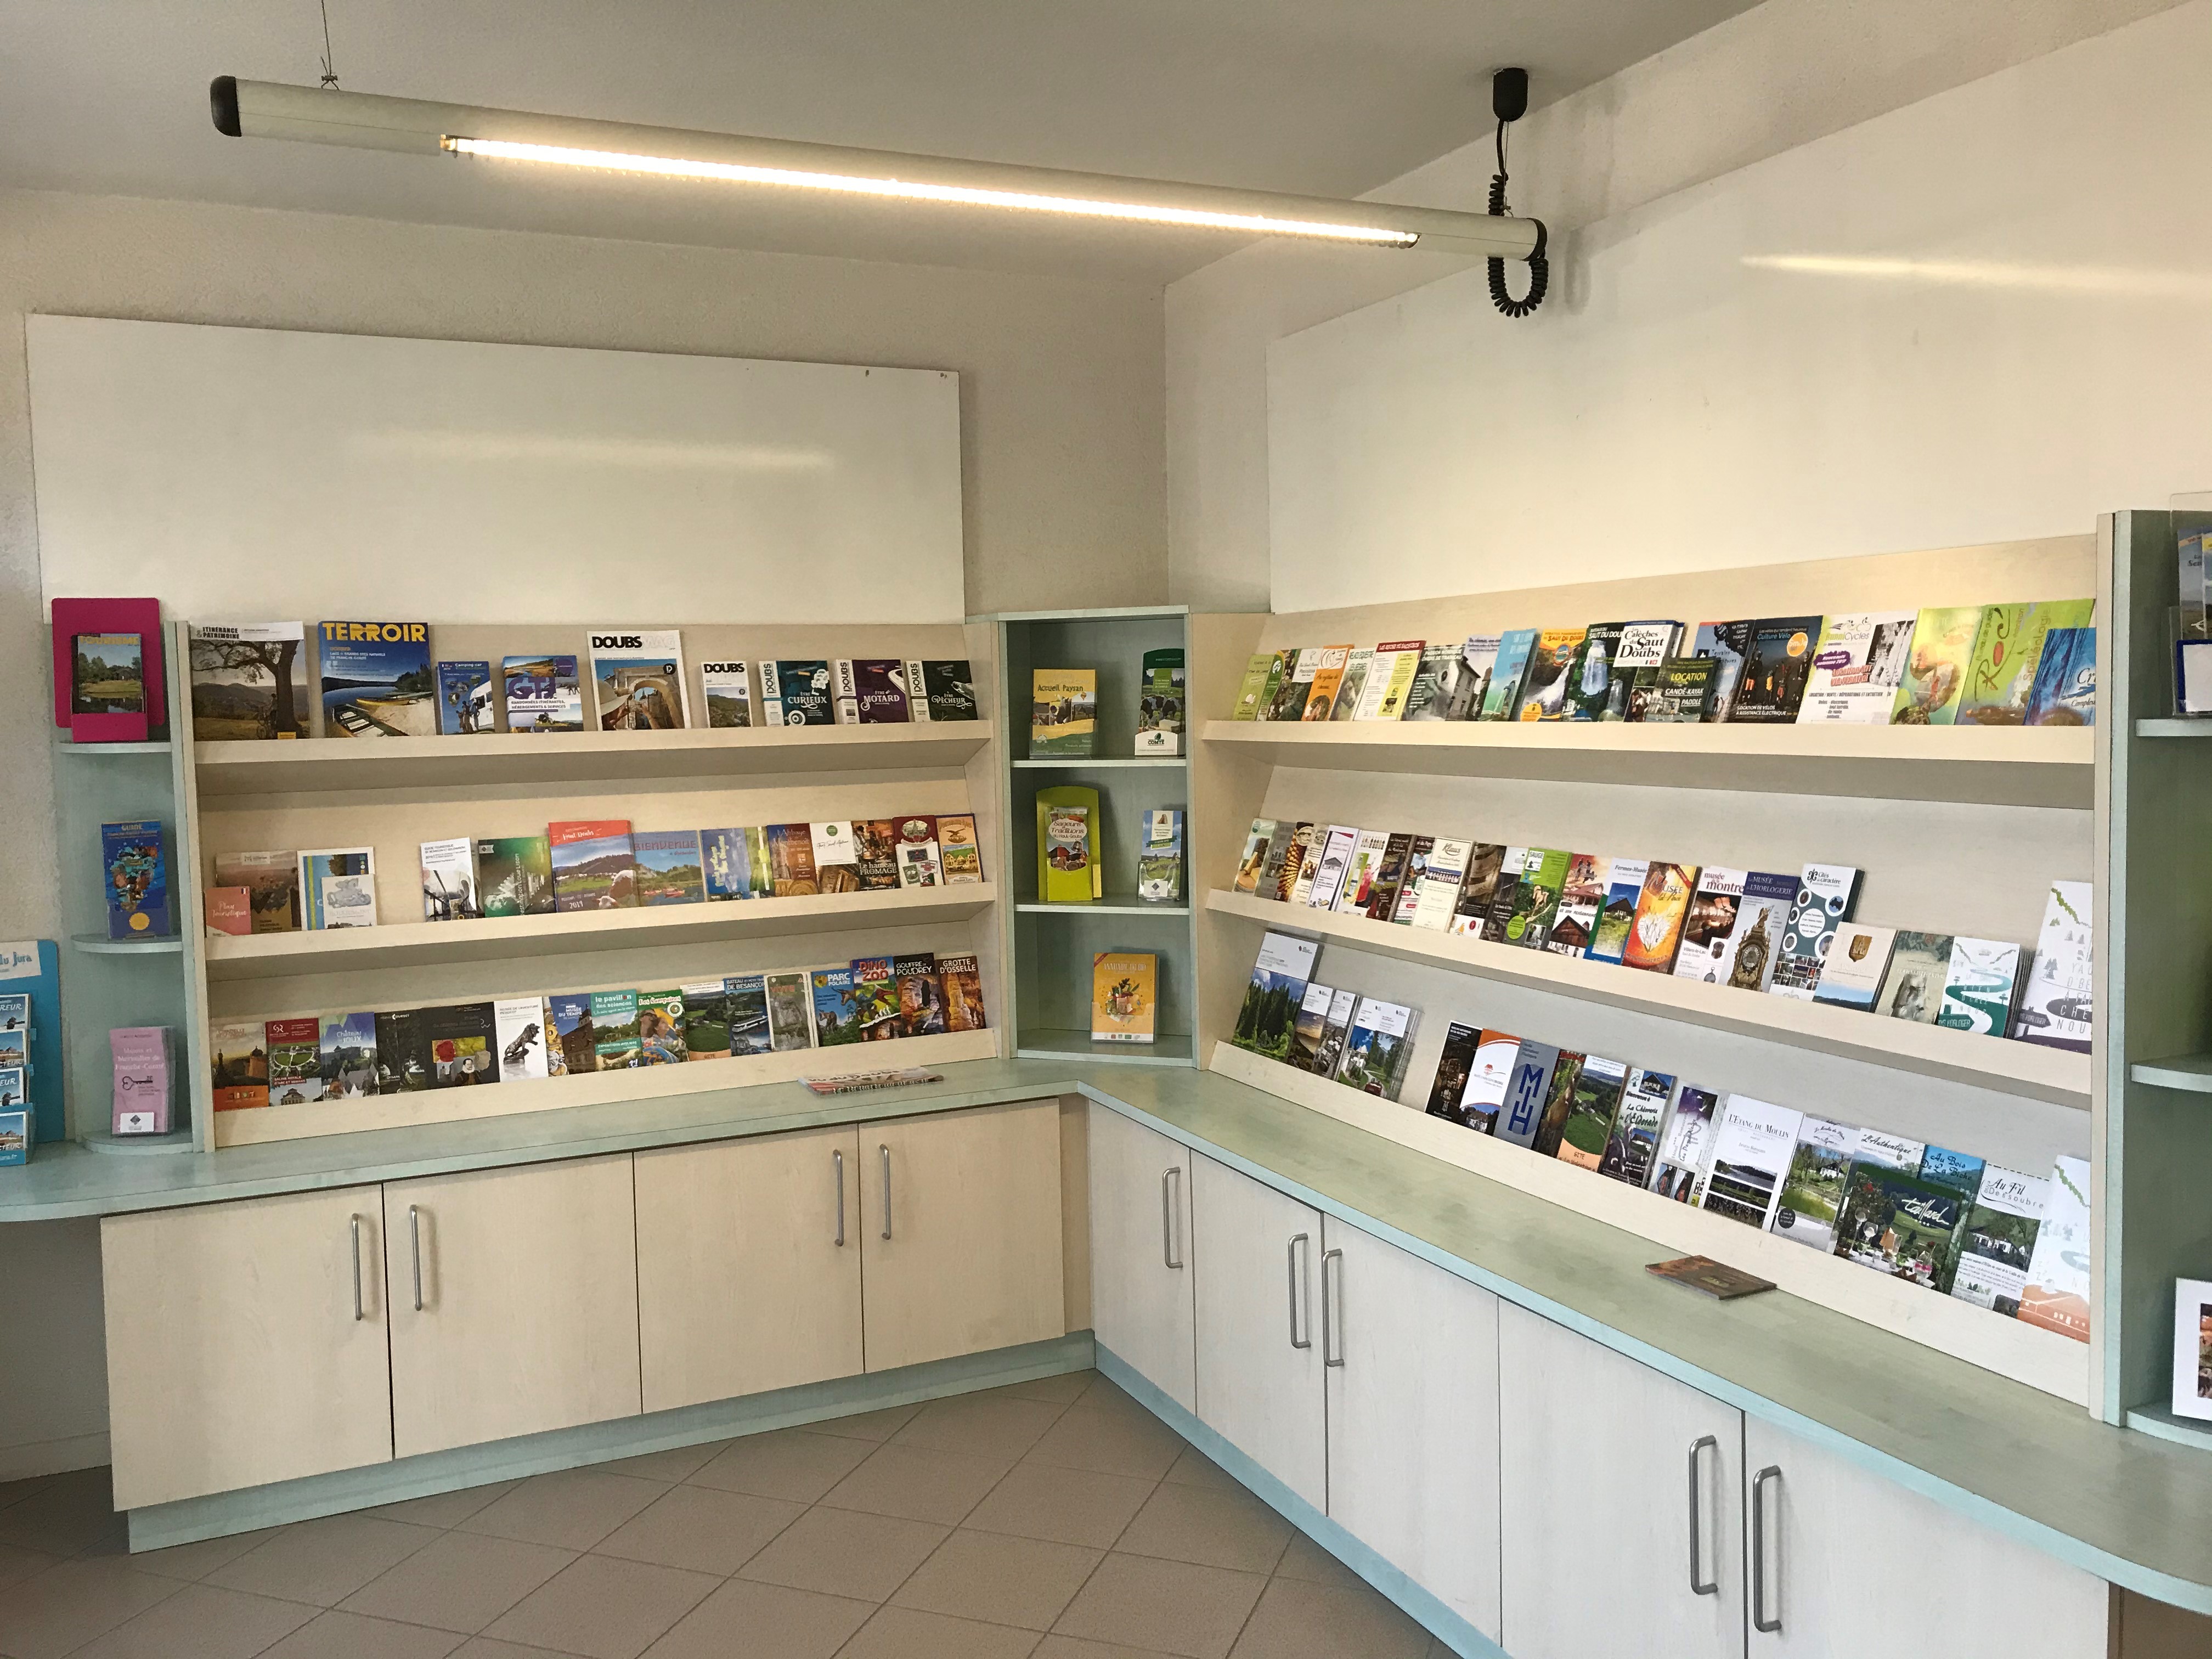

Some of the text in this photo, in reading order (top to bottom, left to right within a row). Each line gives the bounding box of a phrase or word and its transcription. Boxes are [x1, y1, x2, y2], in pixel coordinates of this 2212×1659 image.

[322, 623, 426, 642] TERROIR
[1624, 630, 1658, 640] Calèches
[592, 636, 642, 648] DOUBS
[1635, 637, 1664, 651] Saut
[2023, 608, 2051, 681] Spéléologie
[1620, 645, 1661, 658] Doubs
[703, 663, 745, 674] DOUBS
[1671, 673, 1707, 681] LOCATION
[508, 677, 557, 699] GTJ
[1062, 684, 1084, 692] Paysan
[1664, 687, 1705, 696] CANOË-KAYAK
[788, 695, 827, 708] CURIEUX
[861, 694, 900, 708] MOTARD
[1441, 843, 1462, 855] Klaus
[1753, 876, 1774, 884] MUSÉE
[1706, 881, 1745, 893] montre
[1750, 884, 1793, 895] L'HORLOGERIE
[13, 952, 32, 966] Jura
[896, 961, 923, 969] GOUFFRE
[943, 958, 971, 967] GROTTE
[862, 969, 889, 981] ZOO
[896, 966, 932, 976] POUDREY
[940, 964, 977, 974] D'OSSELLE
[827, 973, 850, 981] PARC
[603, 994, 631, 1003] pavillon
[2063, 989, 2092, 1005] À FAI
[1959, 1005, 1987, 1015] NOUS
[2060, 1005, 2088, 1019] CHE
[2057, 1019, 2086, 1034] NOU
[1765, 1124, 1790, 1138] MOULIN
[1930, 1153, 1966, 1169] Au Bois
[1921, 1158, 1972, 1181] De La Biche
[1987, 1178, 2025, 1195] Au Fil
[1989, 1186, 2044, 1209] Dessoubre
[1901, 1198, 1949, 1226] taillard
